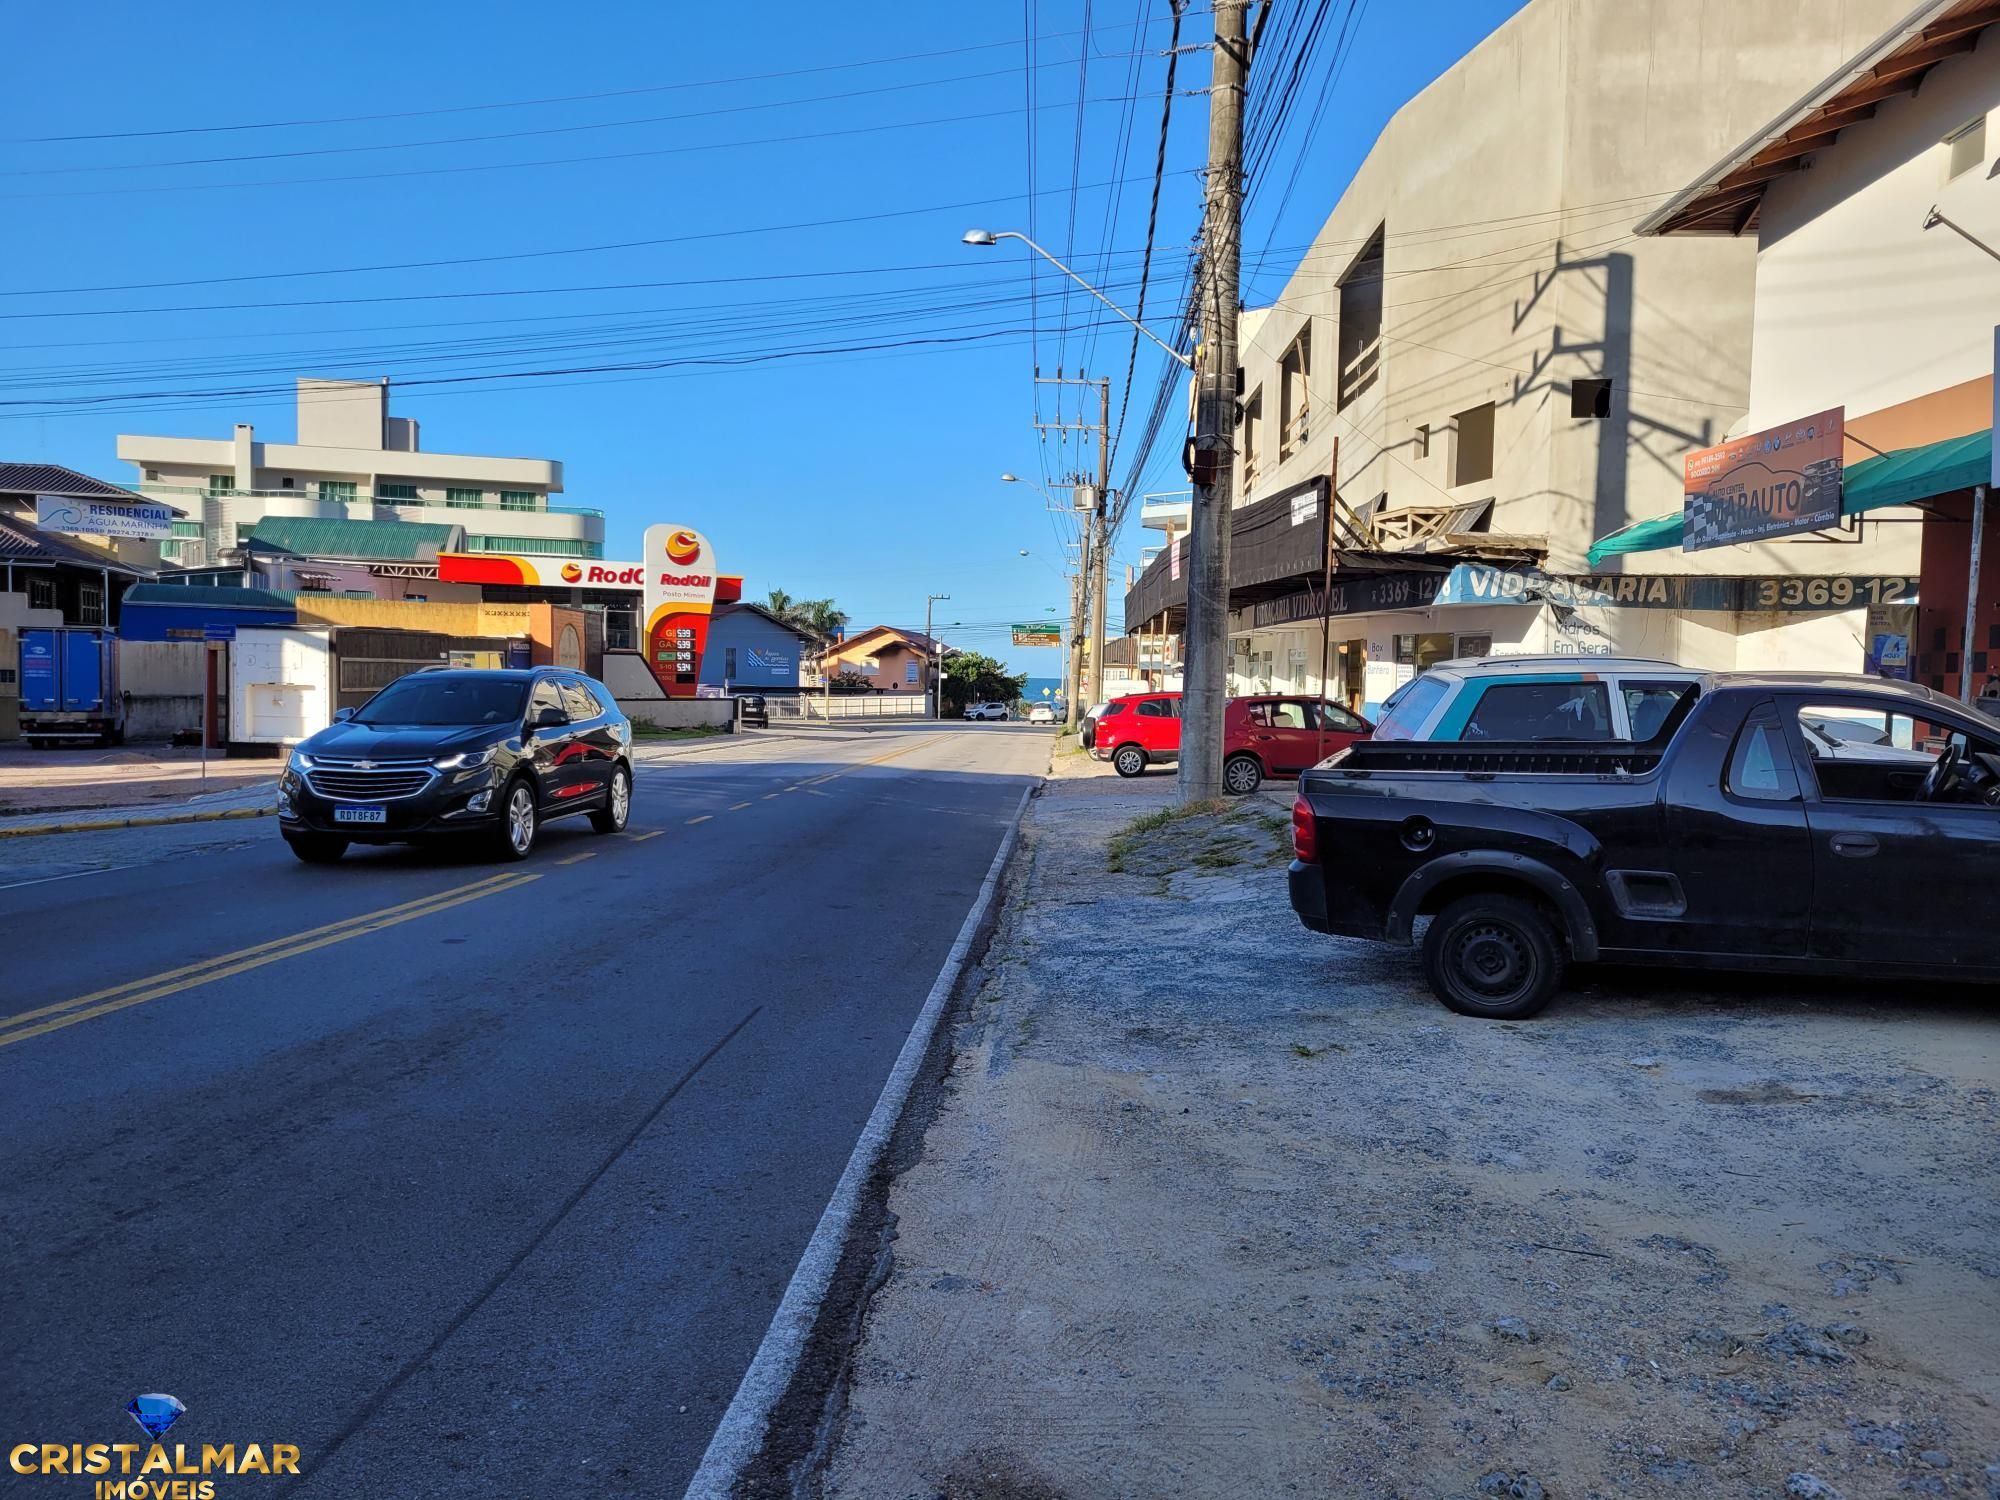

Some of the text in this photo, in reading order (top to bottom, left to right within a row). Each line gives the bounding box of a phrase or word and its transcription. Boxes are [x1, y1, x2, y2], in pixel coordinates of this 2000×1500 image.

[1712, 483, 1745, 497] AUTO CENTER
[90, 504, 168, 520] RESIDENCIAL
[120, 520, 169, 530] MARINHA
[660, 573, 712, 588] RodOil
[663, 590, 682, 598] Posto
[1292, 587, 1348, 618] VIDROEL
[1379, 580, 1409, 604] 3369
[1555, 621, 1600, 636] Vidros
[1371, 642, 1384, 653] Box
[1554, 640, 1612, 655] Em Geral
[340, 810, 381, 821] RDT8F87
